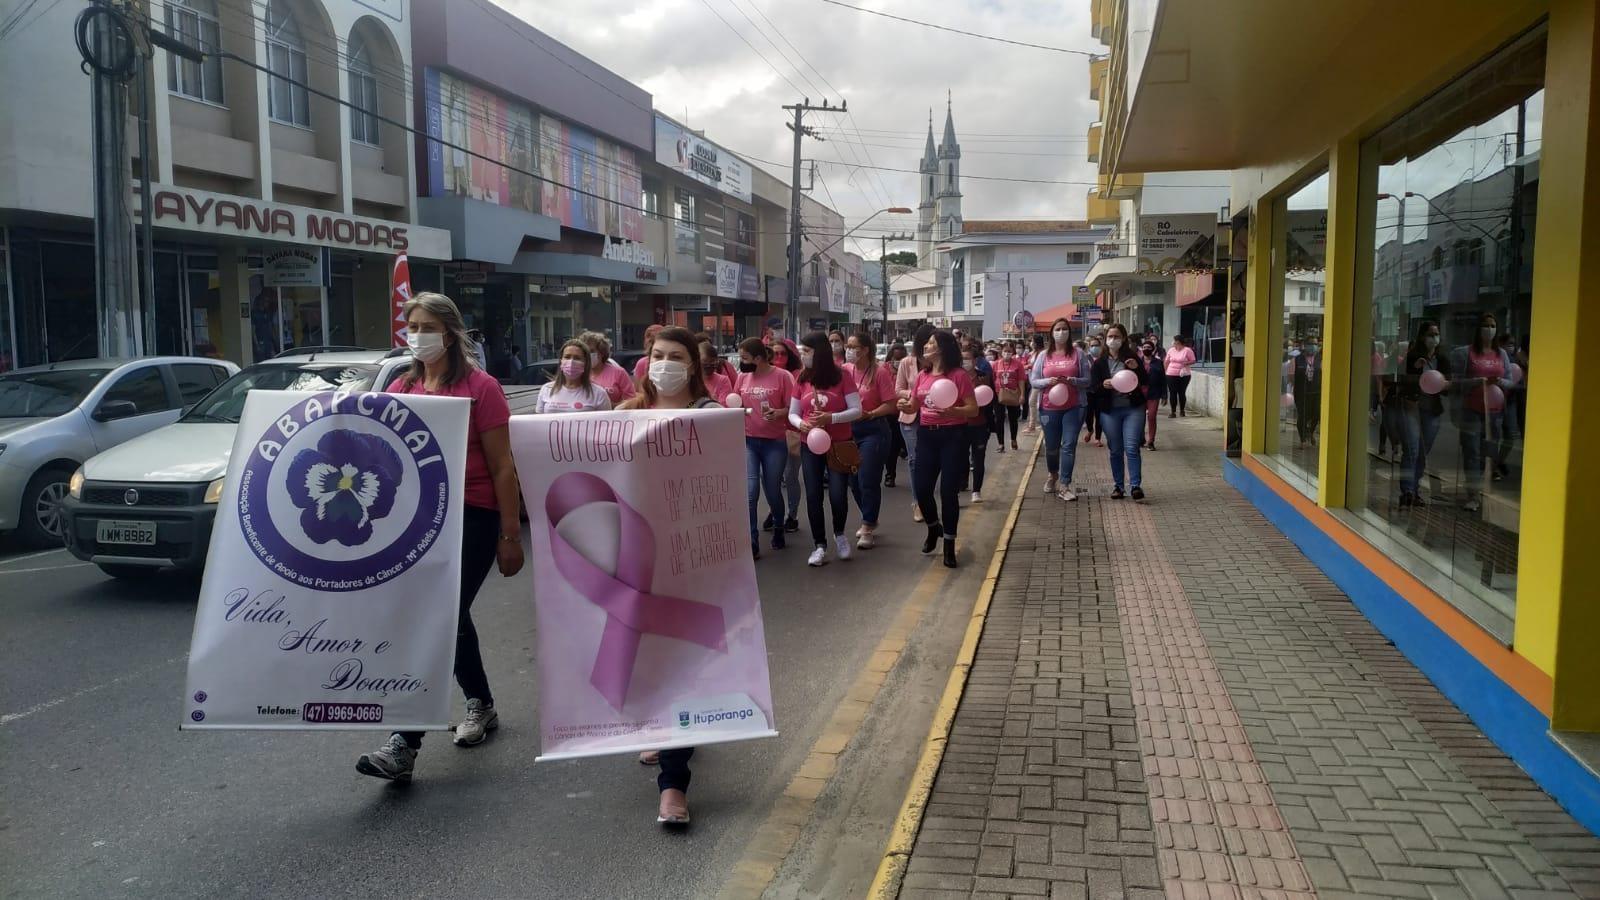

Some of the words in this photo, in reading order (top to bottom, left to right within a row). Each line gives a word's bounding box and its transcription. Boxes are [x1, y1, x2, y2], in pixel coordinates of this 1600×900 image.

[307, 214, 408, 251] MODAS
[258, 391, 442, 467] ABAPCMAI
[549, 419, 634, 462] OUTUBRO
[646, 417, 702, 459] ROSA
[240, 469, 254, 514] Associação
[664, 477, 685, 500] UM
[688, 475, 729, 496] GESTO
[433, 482, 446, 524] Ituporanga
[243, 514, 267, 557] Beneficente
[670, 529, 691, 552] UM
[266, 555, 275, 565] de
[275, 563, 297, 579] Apoio
[376, 562, 403, 580] Câncer
[671, 552, 685, 576] DE
[690, 540, 736, 569] CARINHO
[298, 575, 313, 585] aos
[315, 578, 363, 589] Portadores
[365, 576, 376, 585] de
[224, 587, 291, 627] Vida,
[278, 619, 364, 654] Amor
[375, 640, 391, 654] e
[321, 658, 429, 697] Doação.
[257, 705, 300, 716] Telefone:
[303, 703, 325, 722] (47)
[327, 705, 382, 722] 9969-0669
[693, 708, 753, 726] Ituporanga
